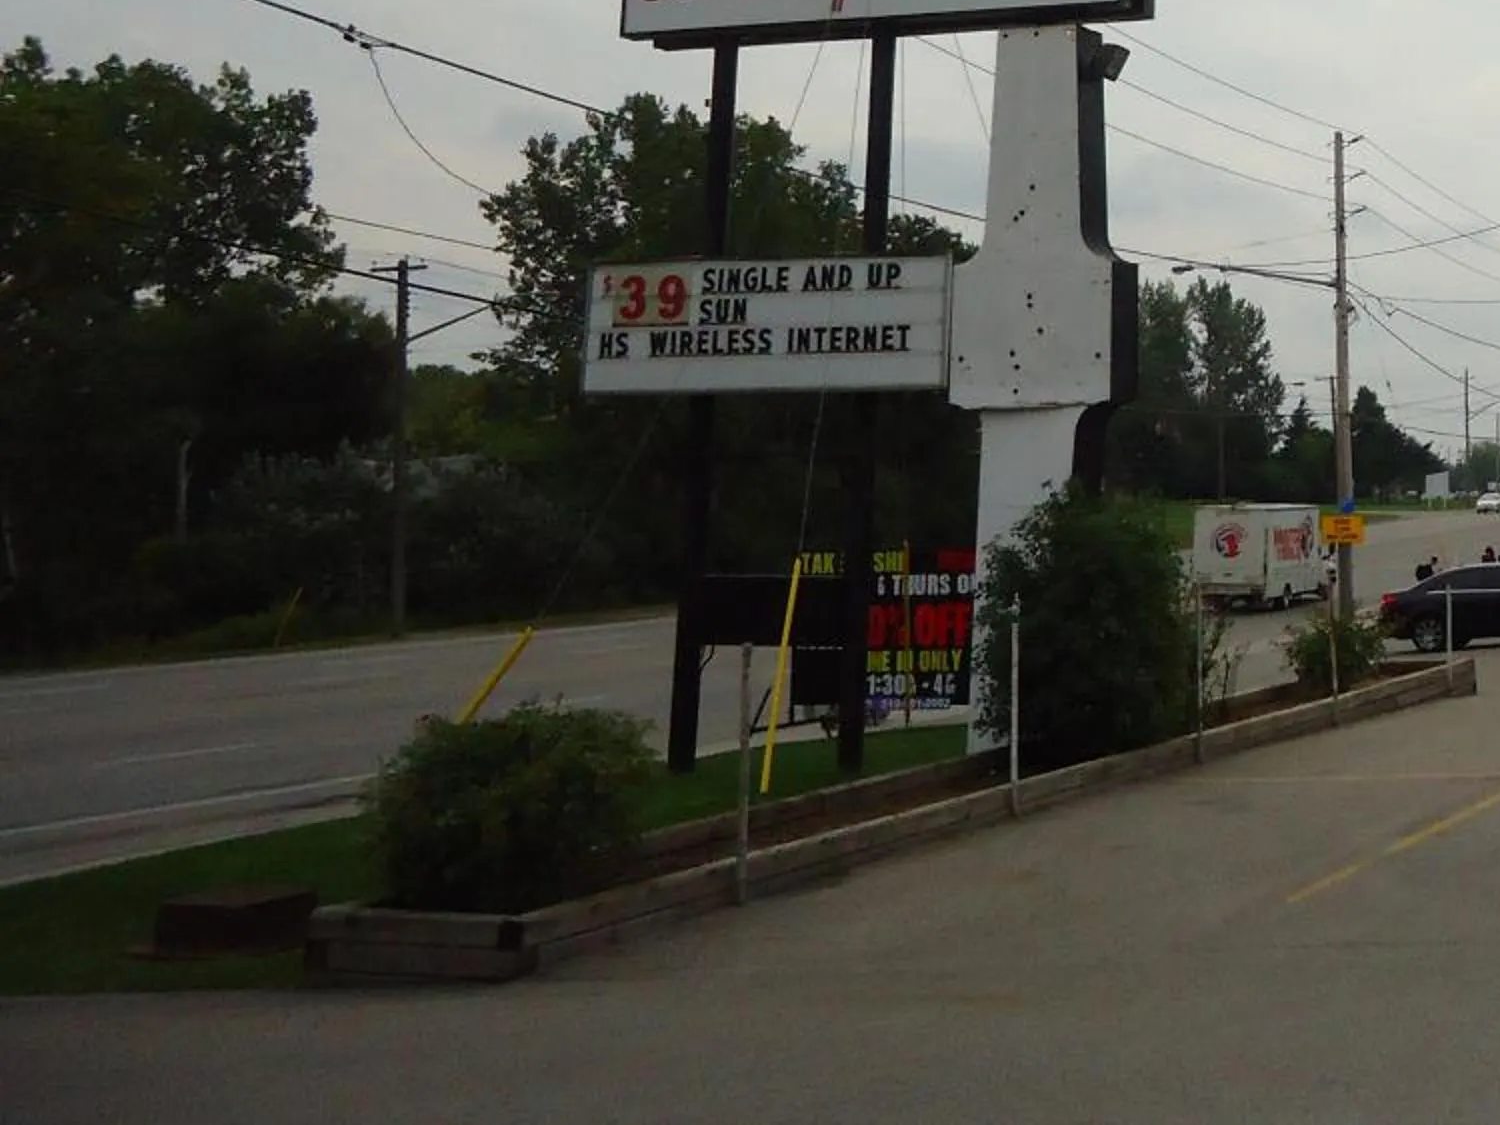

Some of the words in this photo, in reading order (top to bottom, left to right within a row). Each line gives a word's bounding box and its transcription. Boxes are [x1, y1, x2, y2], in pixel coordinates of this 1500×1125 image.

[702, 266, 789, 295] SINGLE
[801, 263, 853, 291] AND
[866, 262, 903, 289] UP
[700, 298, 748, 325] SUN
[599, 332, 629, 359] HS
[649, 328, 773, 357] WIRELESS
[786, 325, 912, 353] INTERNET
